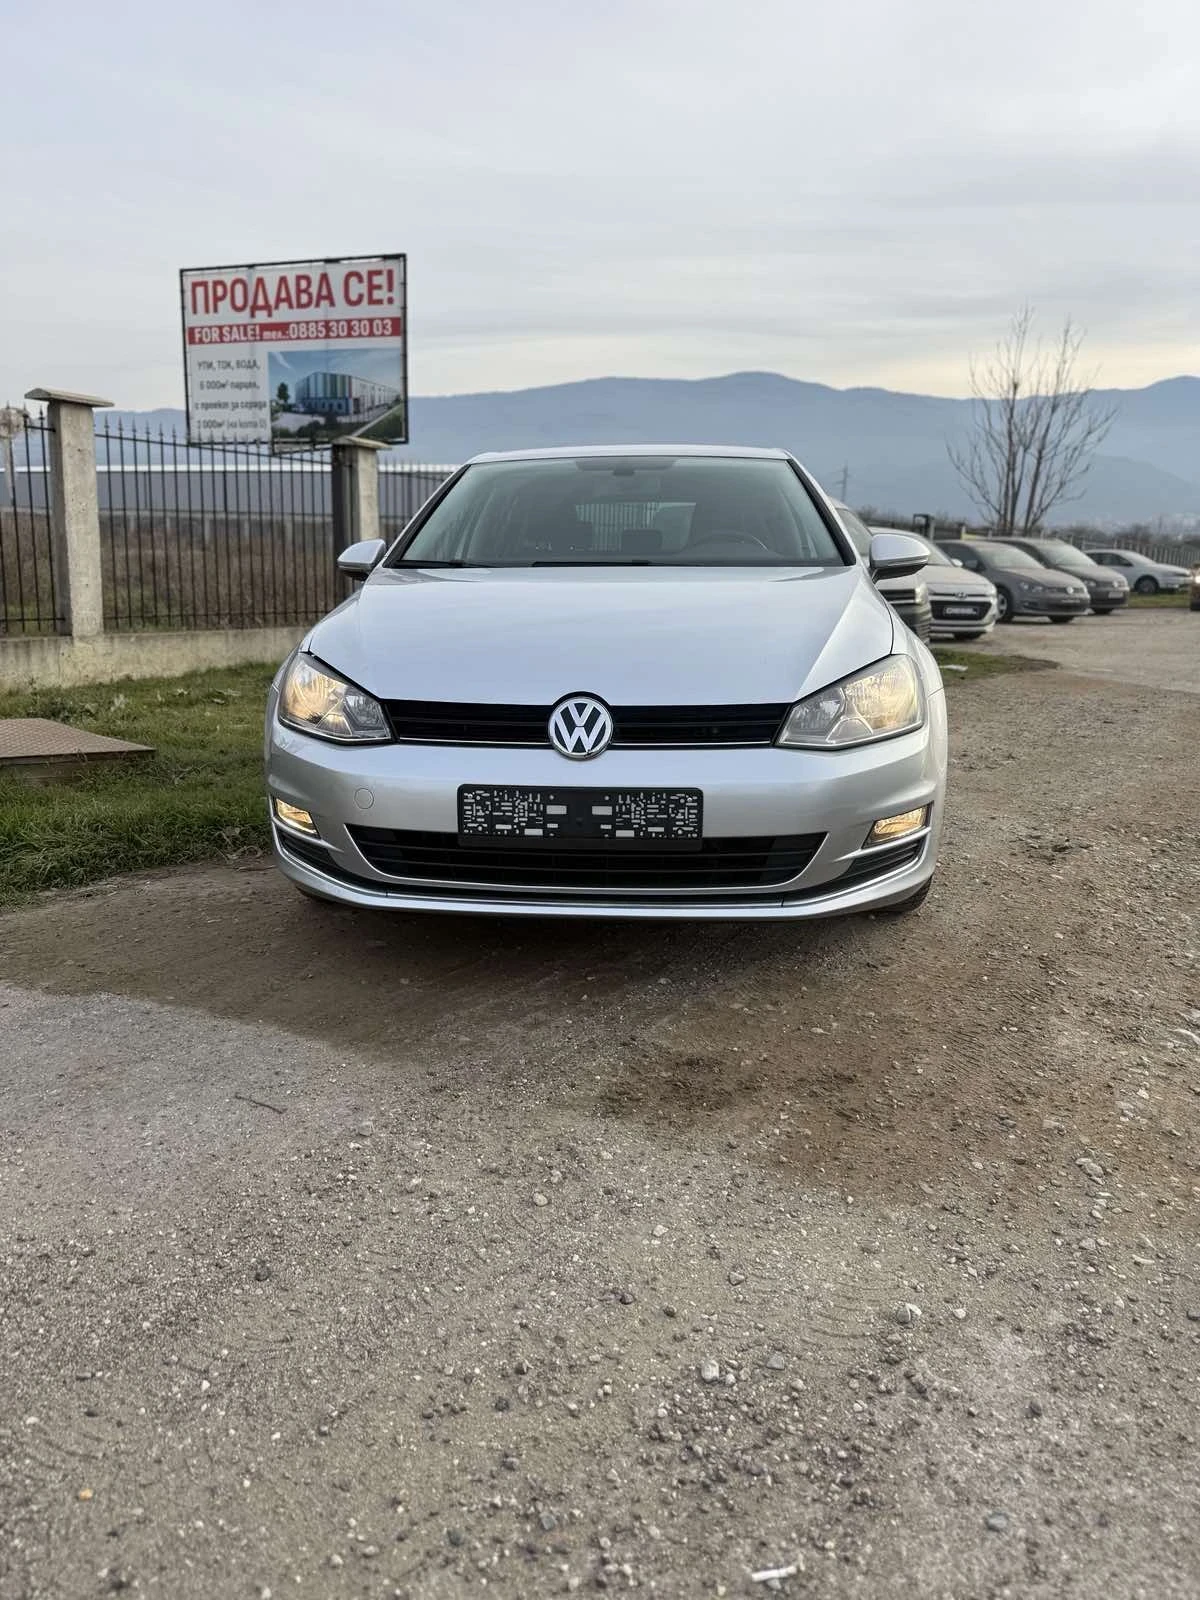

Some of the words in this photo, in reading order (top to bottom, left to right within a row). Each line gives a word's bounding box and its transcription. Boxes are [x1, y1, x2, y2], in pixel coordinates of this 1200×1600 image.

[191, 273, 335, 318] ПРОДАВА
[343, 268, 394, 307] СЕ!
[194, 328, 221, 343] FOR
[223, 325, 260, 342] SALE!
[329, 321, 349, 337] 30
[351, 320, 370, 336] 30
[373, 319, 393, 335] 03
